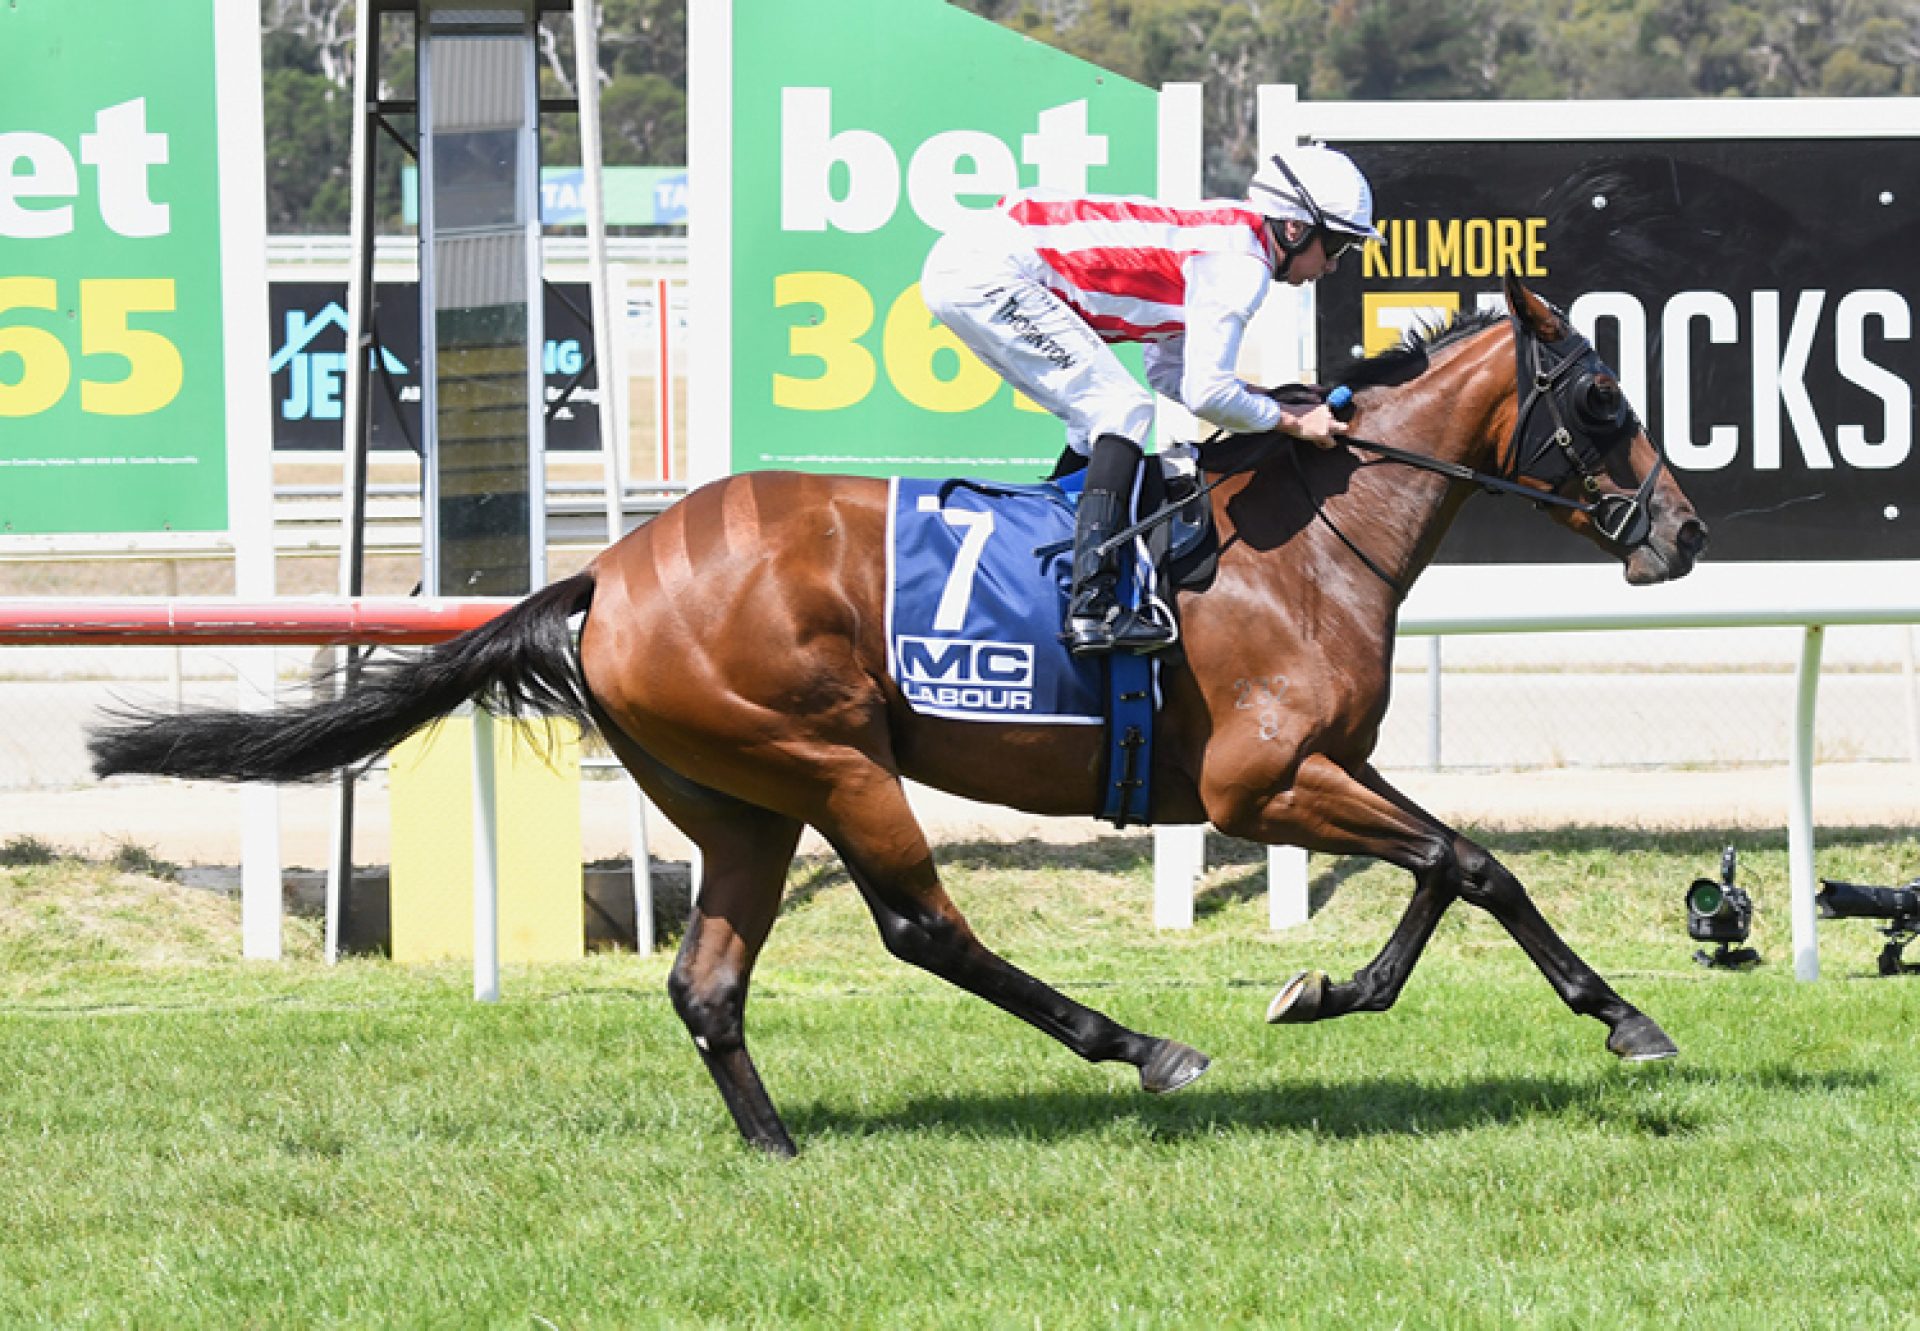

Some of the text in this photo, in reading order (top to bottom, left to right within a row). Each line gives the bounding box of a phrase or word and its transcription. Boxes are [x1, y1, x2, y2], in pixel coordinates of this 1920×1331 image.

[0, 96, 171, 238] et
[542, 183, 586, 209] TA
[781, 87, 1109, 233] bet
[1362, 218, 1548, 277] KILMORE
[0, 276, 184, 418] 65
[281, 352, 376, 420] JE
[772, 271, 1051, 413] 36
[1476, 289, 1911, 470] OCKS
[916, 495, 994, 631] 7
[902, 639, 1030, 683] MC
[902, 680, 1033, 710] LABOUR
